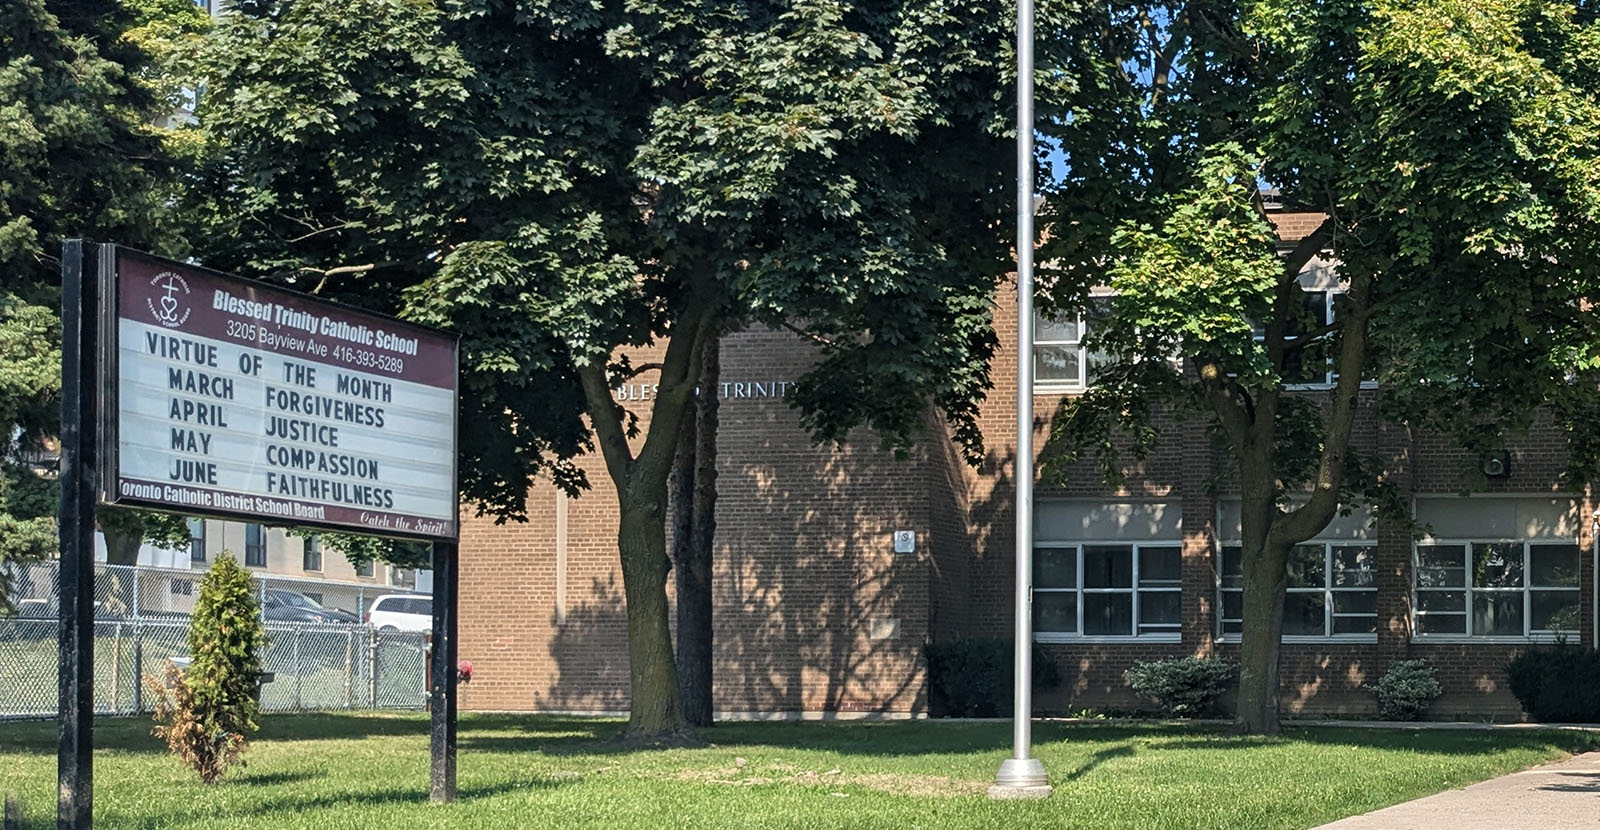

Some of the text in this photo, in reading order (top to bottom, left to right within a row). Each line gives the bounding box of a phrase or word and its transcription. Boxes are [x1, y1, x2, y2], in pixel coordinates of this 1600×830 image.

[213, 289, 418, 356] Blessed Trinity Catholic School
[226, 320, 403, 373] 3205 Bayview Ave 416-393-5289
[146, 331, 392, 403] VIRTUE OF THE MONTH
[169, 367, 385, 428] MARCH FORGIVENESS
[170, 398, 339, 447] APRIL JUSTICE
[171, 428, 378, 480] MAY COMPASSION
[163, 485, 211, 506] Catholic
[213, 491, 254, 512] District
[255, 497, 293, 516] School
[294, 502, 325, 519] Board
[169, 459, 393, 509] JUNE FAITHFULNESS
[360, 511, 447, 534] Catch the Spirit!
